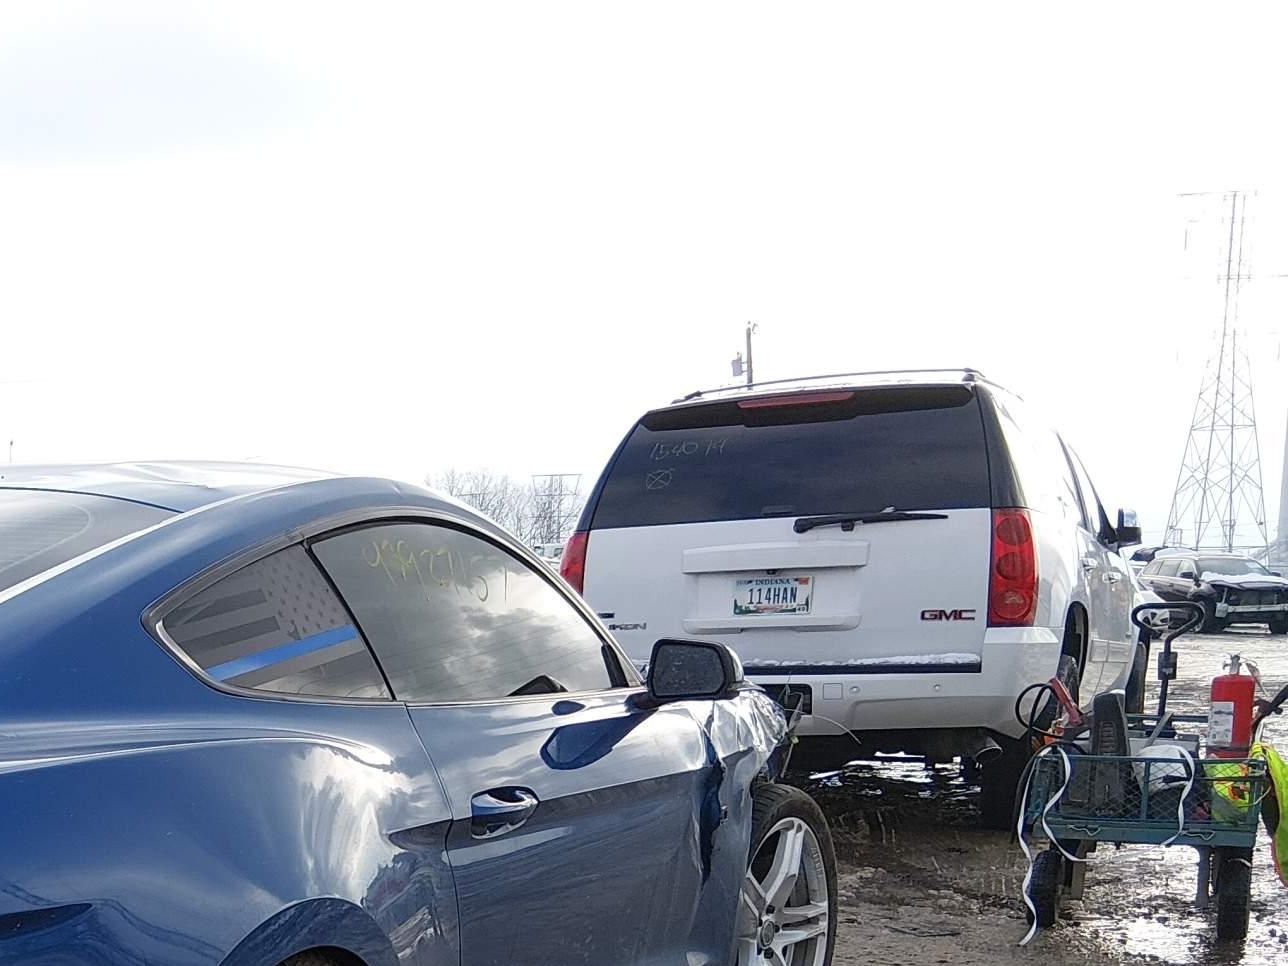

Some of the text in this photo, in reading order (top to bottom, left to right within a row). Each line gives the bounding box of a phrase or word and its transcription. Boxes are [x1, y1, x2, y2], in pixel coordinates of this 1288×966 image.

[755, 578, 791, 586] INDIANA
[747, 586, 798, 605] 114HAN
[920, 609, 977, 621] GMC
